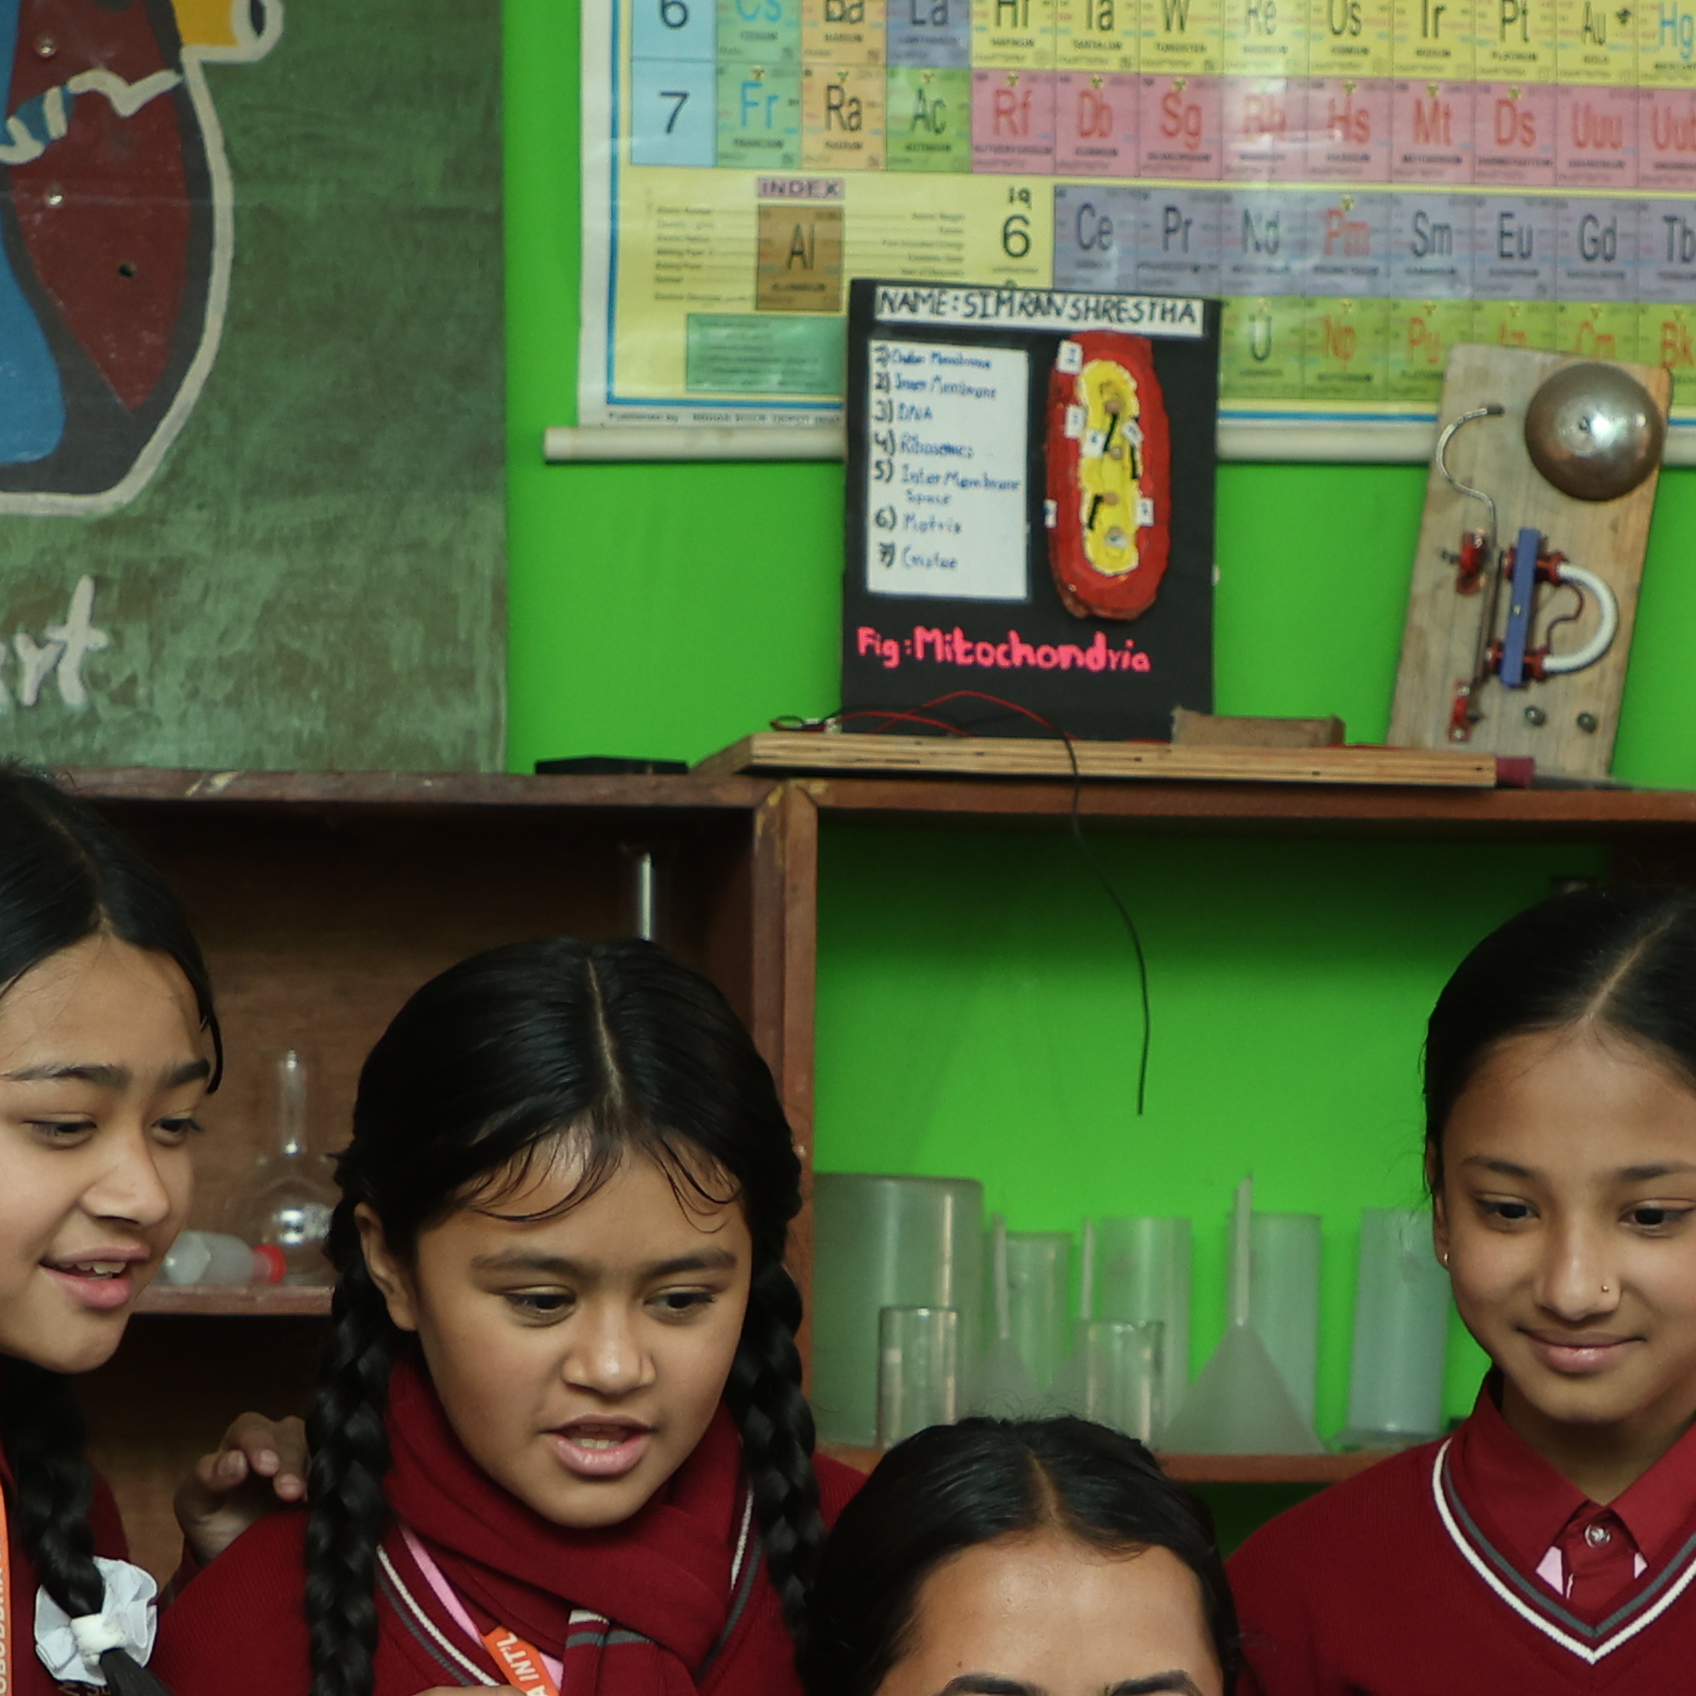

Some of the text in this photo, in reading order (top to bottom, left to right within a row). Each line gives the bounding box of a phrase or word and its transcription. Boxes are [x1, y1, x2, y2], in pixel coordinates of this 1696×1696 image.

[1659, 0, 1694, 61] Hg
[659, 92, 690, 135] 7
[740, 81, 780, 130] Fr
[826, 84, 863, 132] Ra
[911, 88, 947, 136] Ac
[993, 88, 1032, 136] Rf
[1076, 91, 1114, 139] Db
[1160, 92, 1202, 152] Sg
[1328, 98, 1372, 145] Hs
[1413, 98, 1453, 147] Mt
[1495, 98, 1537, 148] Ds
[760, 178, 841, 198] INDEX
[787, 222, 815, 271] Al
[1002, 213, 1032, 258] 6
[1076, 202, 1114, 251] Ce
[1162, 206, 1193, 253] Pr
[1242, 208, 1281, 255] Nd
[1324, 208, 1371, 257] Pm
[1411, 211, 1453, 259] Sm
[1498, 212, 1534, 261] Eu
[1578, 214, 1618, 263] Gd
[1663, 215, 1696, 264] Tb
[964, 289, 1066, 322] SIMRAN
[1068, 297, 1198, 325] SHRESTHA
[1249, 315, 1273, 363] U
[1324, 316, 1357, 369] Np
[872, 459, 895, 484] 5)
[874, 505, 897, 531] 6)
[912, 624, 1153, 674] Mitochondria
[495, 1631, 541, 1684] INT'L
